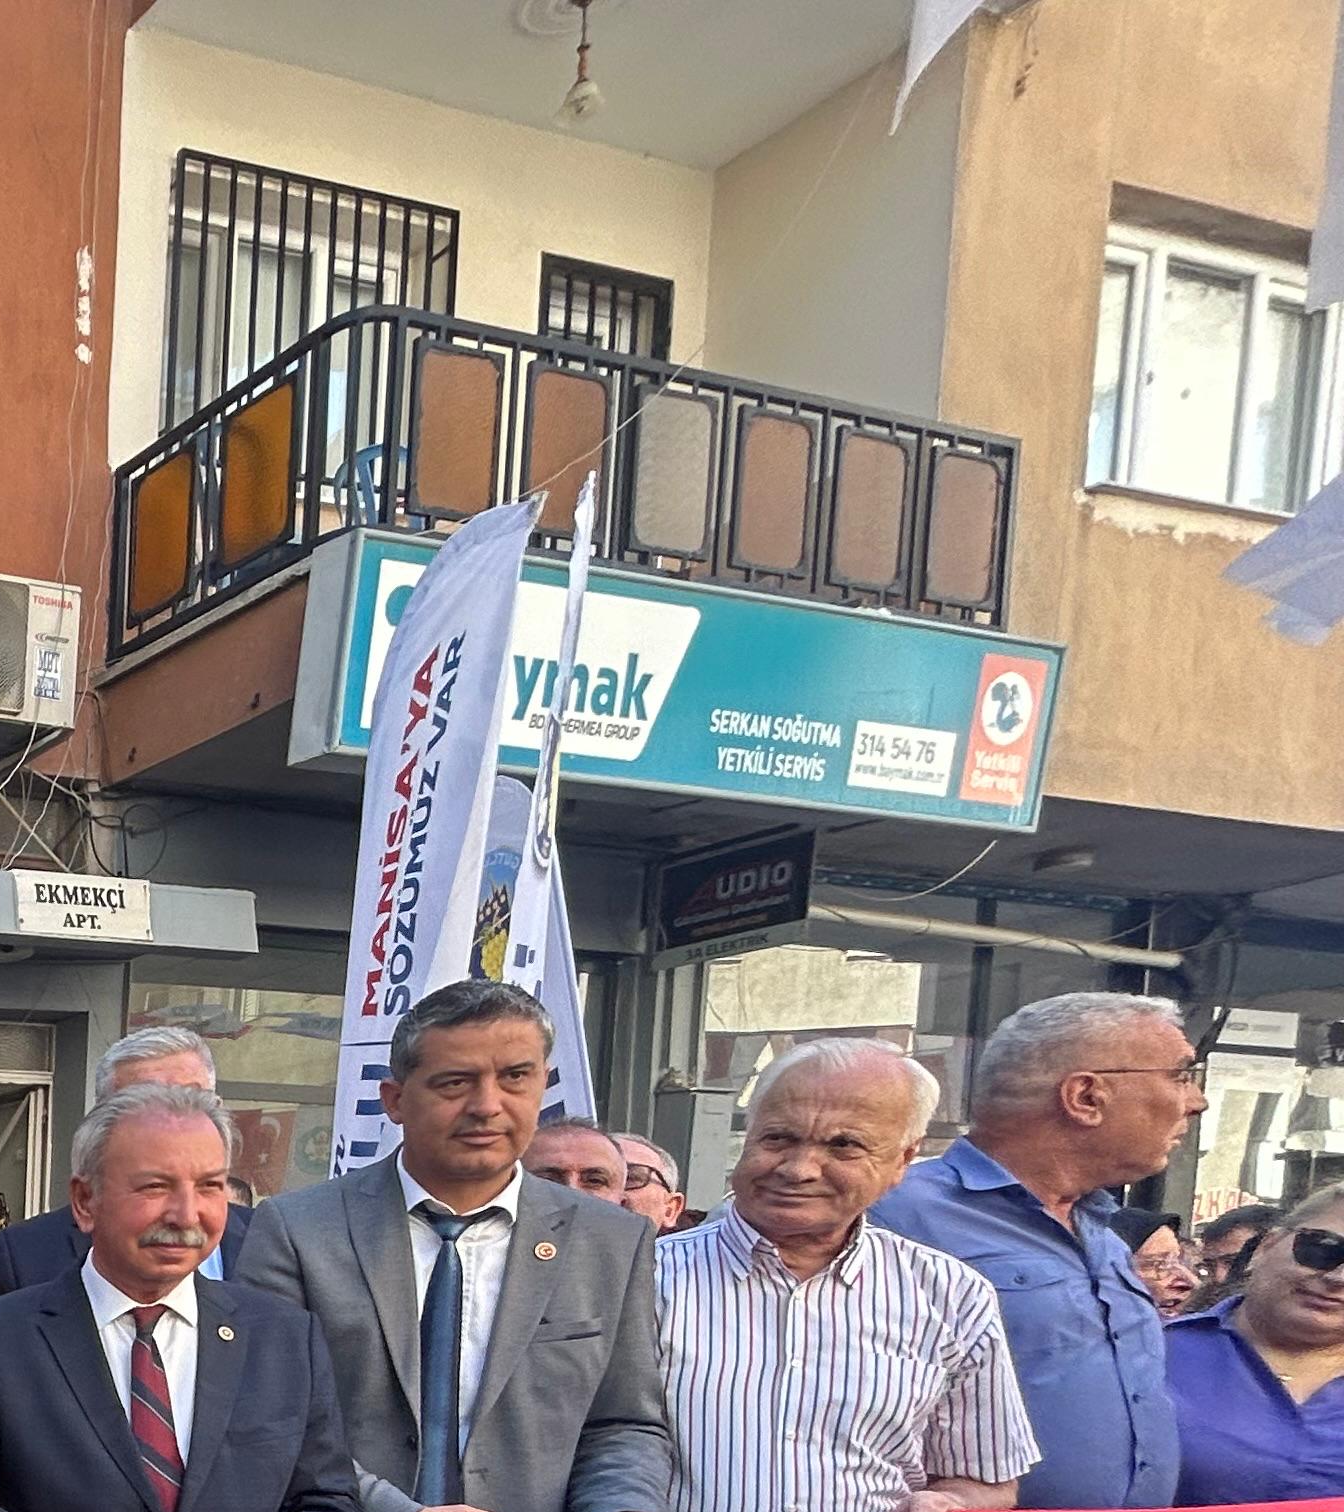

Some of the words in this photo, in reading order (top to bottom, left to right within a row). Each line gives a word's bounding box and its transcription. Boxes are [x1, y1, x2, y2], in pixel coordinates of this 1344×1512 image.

[33, 595, 73, 610] TOSHIBA
[511, 653, 653, 721] ymak
[604, 723, 641, 740] GROUP
[709, 708, 772, 739] SERKAN
[772, 713, 841, 748] SOĞUTMA
[717, 744, 775, 776] YETKİLİ
[773, 751, 826, 782] SERVİS
[857, 733, 885, 758] 314
[890, 737, 912, 760] 54
[915, 740, 937, 764] 76
[361, 642, 441, 1017] MANİSA'YA
[383, 760, 441, 1016] SÖZÜMÜZ
[425, 629, 467, 756] VAR
[34, 882, 126, 914] EKMEKÇİ
[63, 912, 102, 930] APT.
